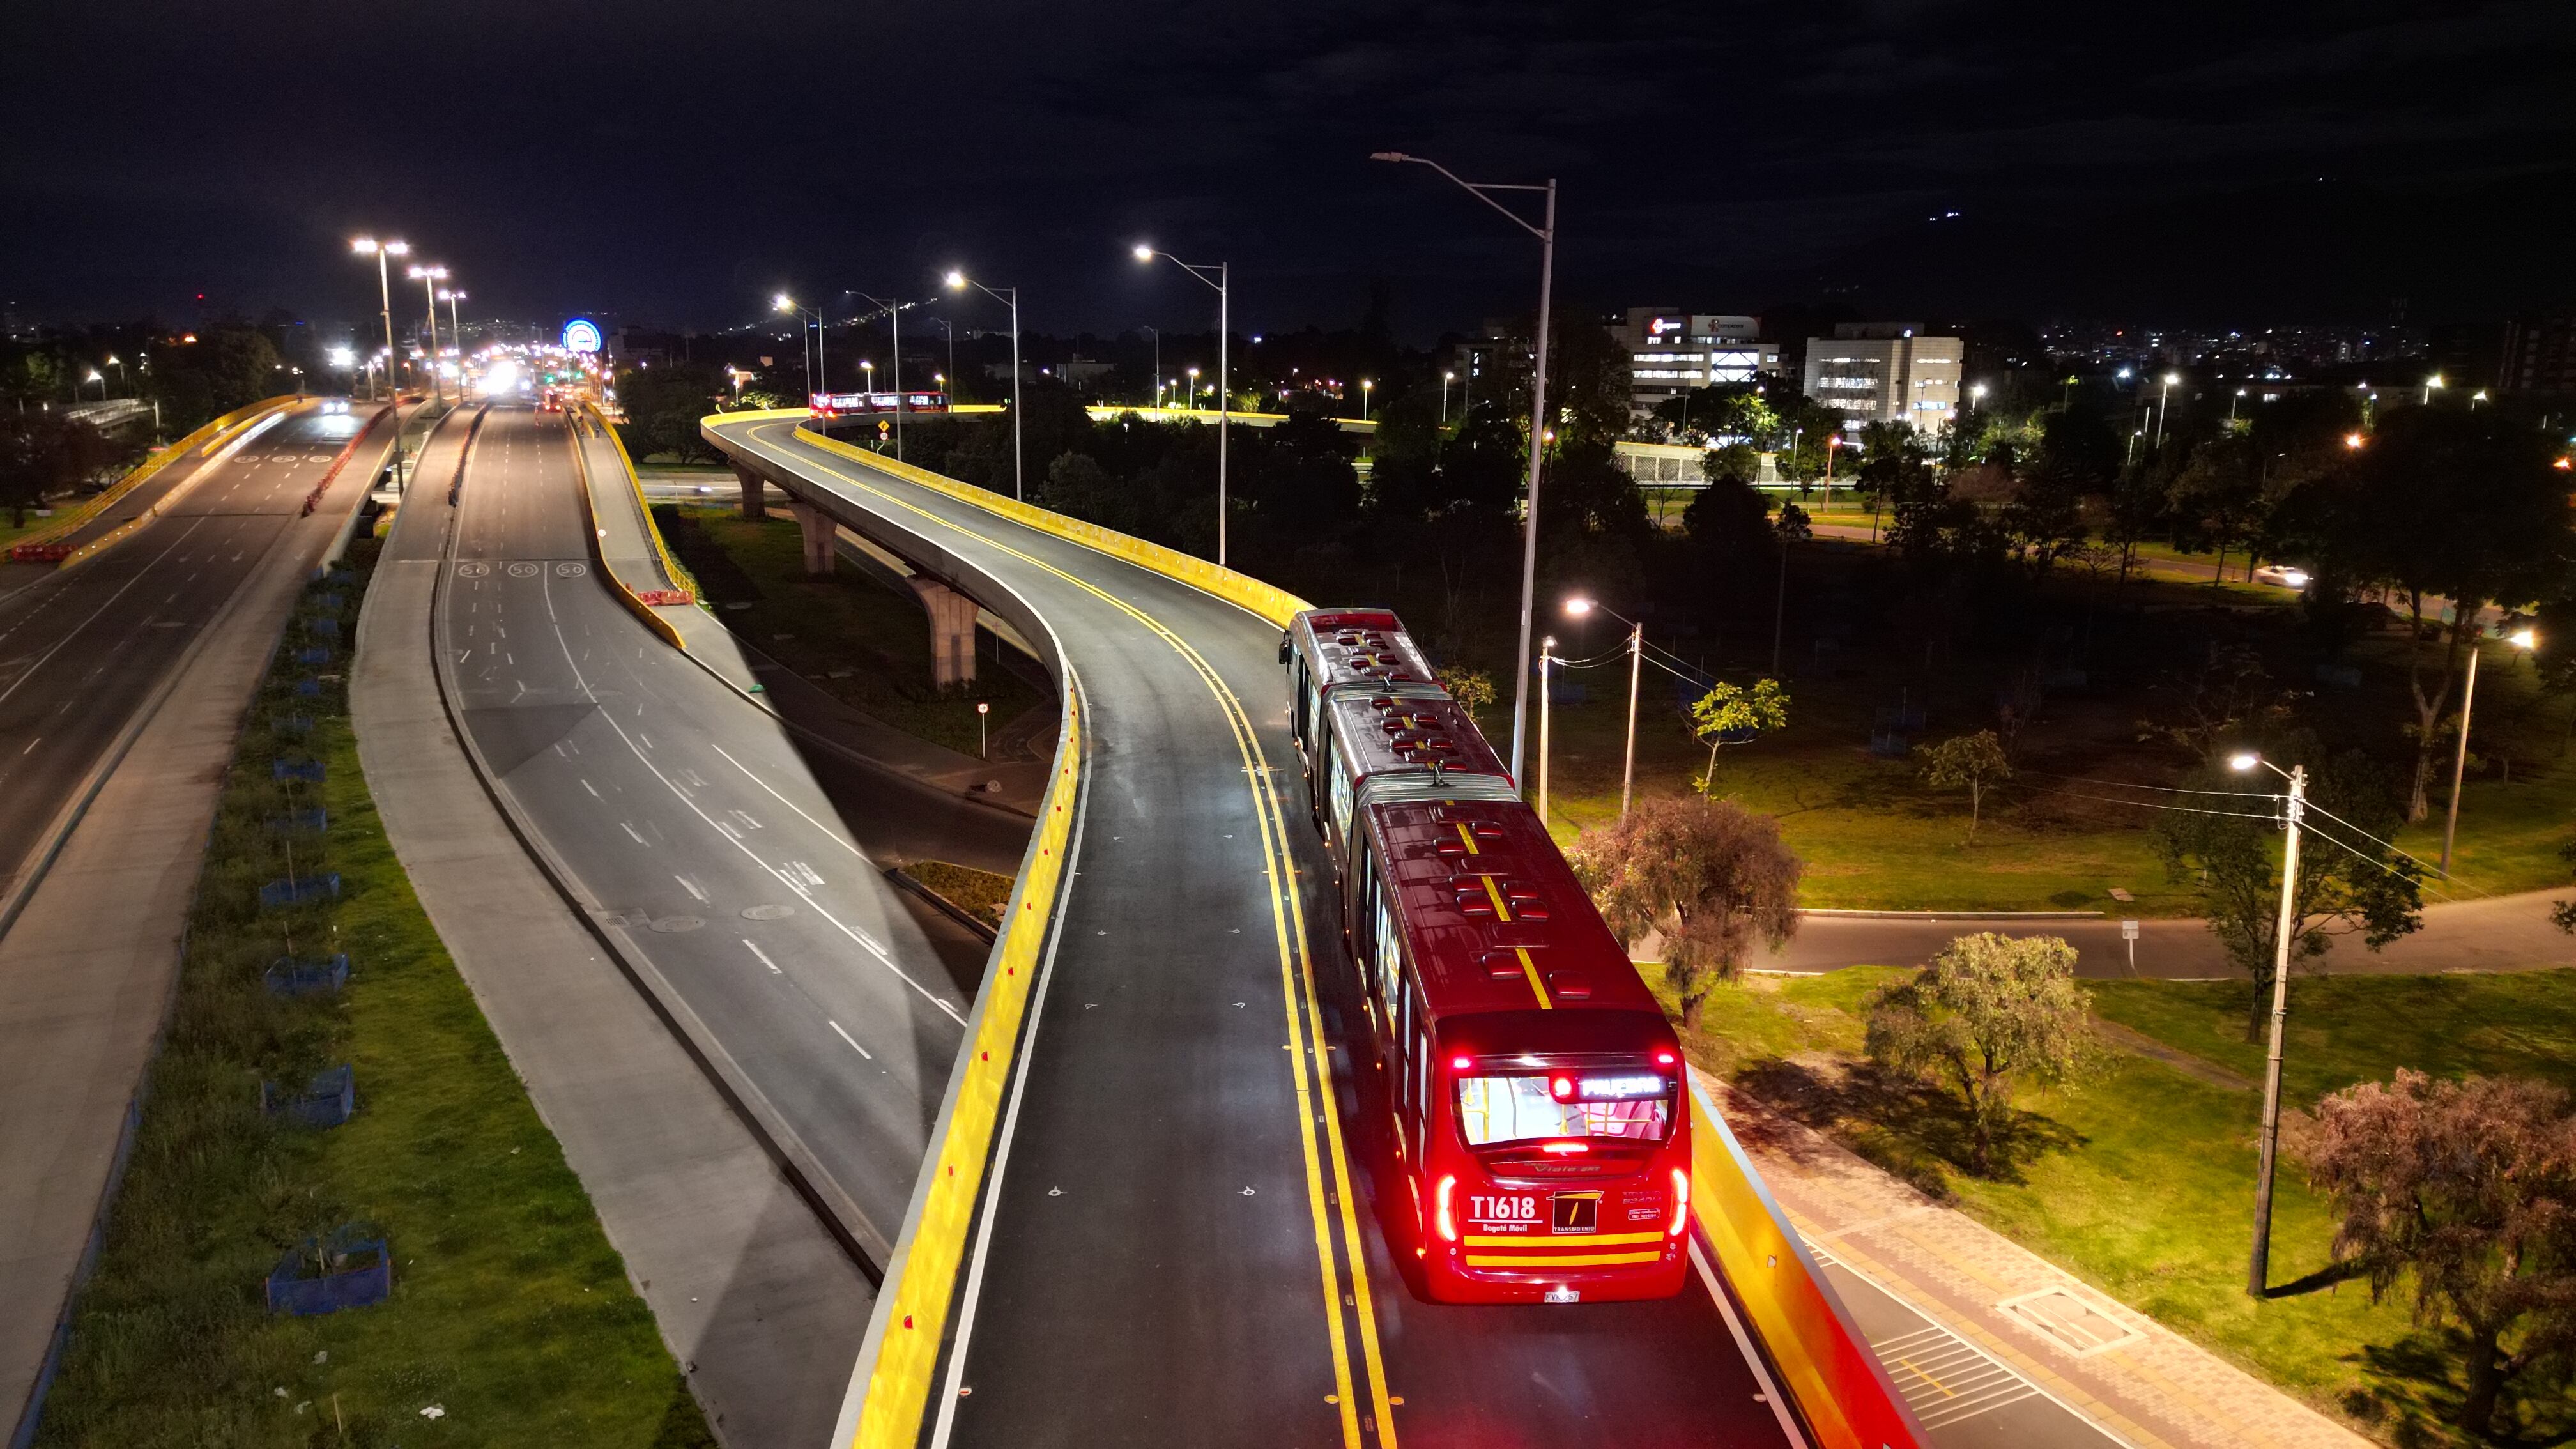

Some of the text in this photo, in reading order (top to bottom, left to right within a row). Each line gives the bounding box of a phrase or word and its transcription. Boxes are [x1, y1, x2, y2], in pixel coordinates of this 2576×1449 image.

[513, 566, 535, 574] 50
[560, 566, 582, 574] 50
[1470, 1196, 1535, 1219] T1618
[1483, 1223, 1528, 1233] Bogotá Móvil
